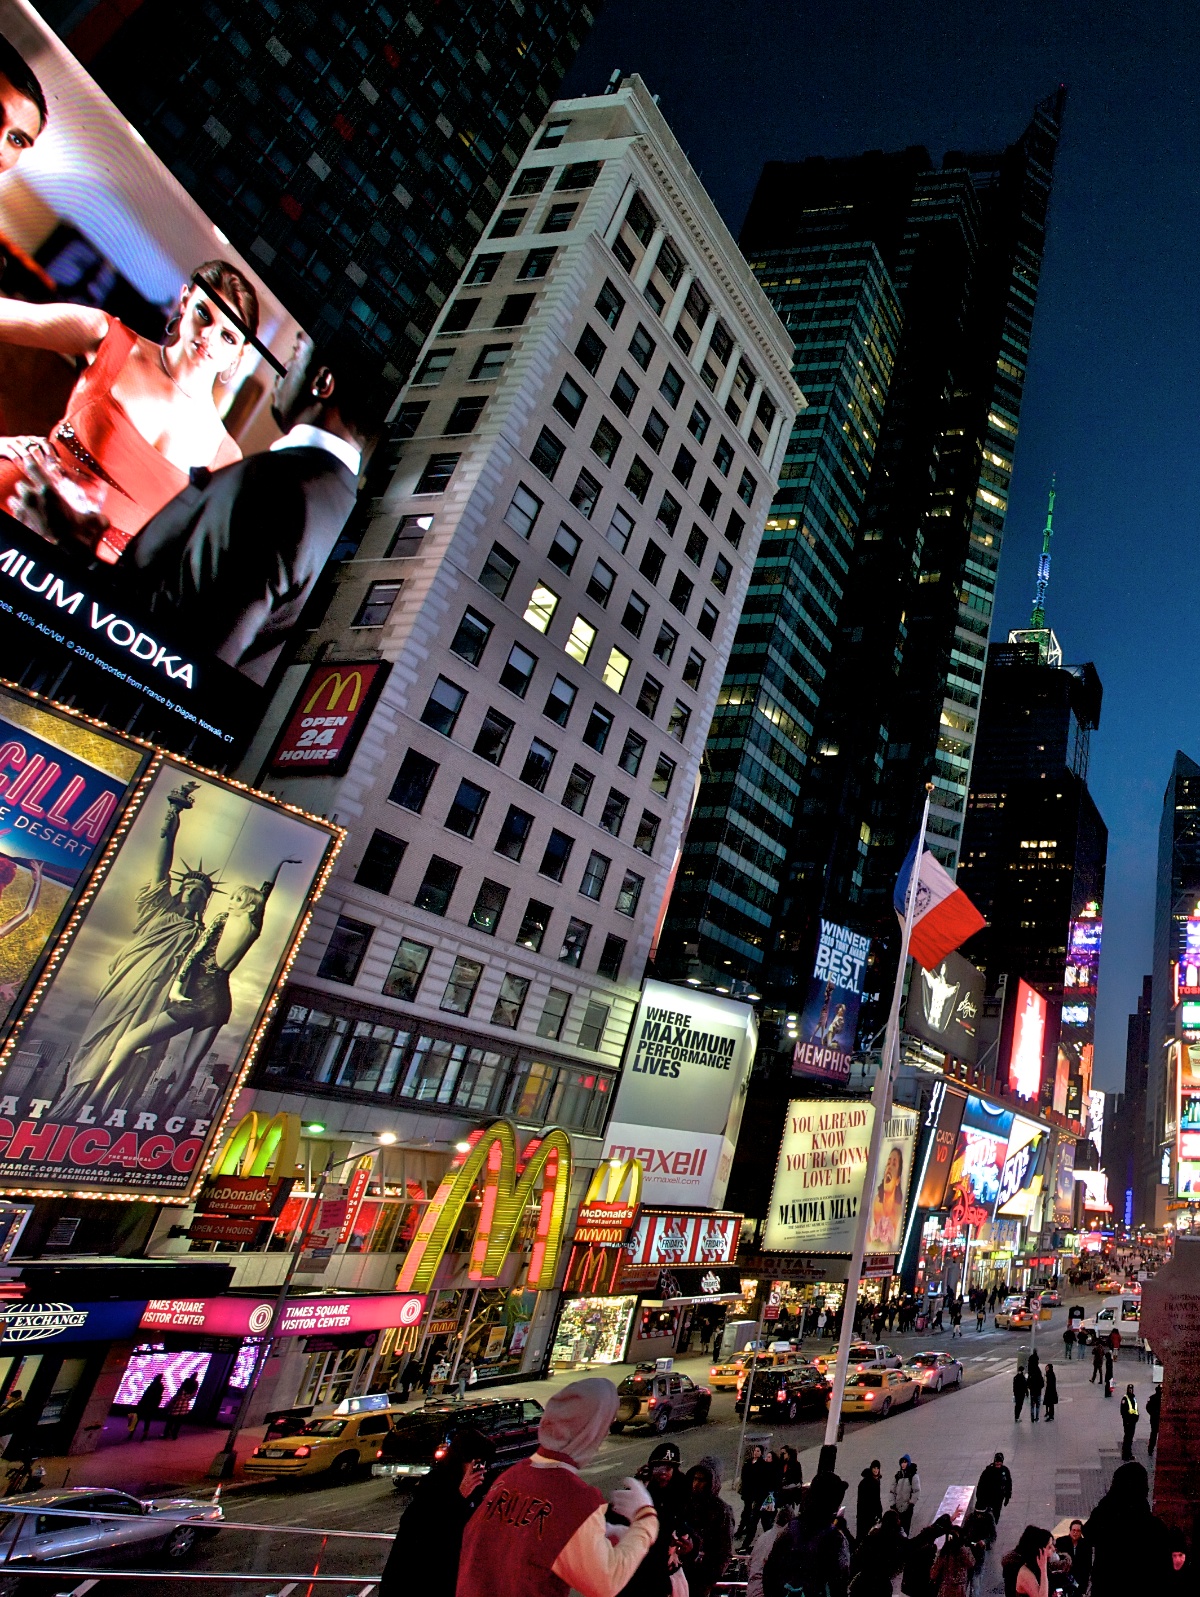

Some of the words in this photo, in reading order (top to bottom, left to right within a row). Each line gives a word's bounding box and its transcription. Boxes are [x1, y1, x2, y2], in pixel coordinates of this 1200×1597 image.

[90, 602, 193, 689] VODKA
[74, 646, 94, 661] 2010
[94, 657, 127, 680] Imported
[126, 676, 142, 690] from
[143, 686, 166, 704] France
[165, 699, 175, 709] by
[224, 735, 235, 743] CT
[300, 716, 348, 728] OPEN
[296, 729, 335, 746] 24
[279, 749, 339, 761] HOURS
[13, 815, 91, 857] DESERT
[820, 934, 835, 946] 2010
[821, 918, 871, 951] WINNER!
[815, 946, 864, 980] BEST
[813, 966, 860, 994] MUSICAL
[646, 1006, 692, 1028] WHERE
[640, 1021, 736, 1057] MAXIMUM
[636, 1040, 732, 1070] PERFORMANCE
[793, 1041, 852, 1074] MEMPHIS
[632, 1055, 682, 1079] LIVES
[0, 1095, 52, 1118] AT
[76, 1105, 211, 1136] LARGE
[792, 1116, 815, 1134] YOU
[817, 1110, 868, 1131] ALREADY
[812, 1130, 847, 1150] KNOW
[786, 1151, 828, 1172] YOU'RE
[832, 1146, 869, 1166] GONNA
[803, 1169, 833, 1189] LOVE
[836, 1167, 851, 1185] IT!
[204, 1187, 272, 1203] McDonald's
[208, 1201, 256, 1211] Restaurant
[580, 1208, 634, 1219] McDonald's
[778, 1200, 825, 1226] MAMMA
[828, 1197, 857, 1220] MIA!
[190, 1224, 213, 1234] OPEN
[213, 1225, 225, 1235] 24
[225, 1225, 254, 1236] HOURS
[171, 1300, 205, 1313] SQUARE
[286, 1307, 314, 1317] TIMES
[315, 1304, 350, 1316] SQUARE
[14, 1315, 87, 1327] EXCHANGE
[172, 1312, 205, 1326] CENTER
[281, 1318, 316, 1331] VISITOR
[317, 1316, 350, 1328] CENTER
